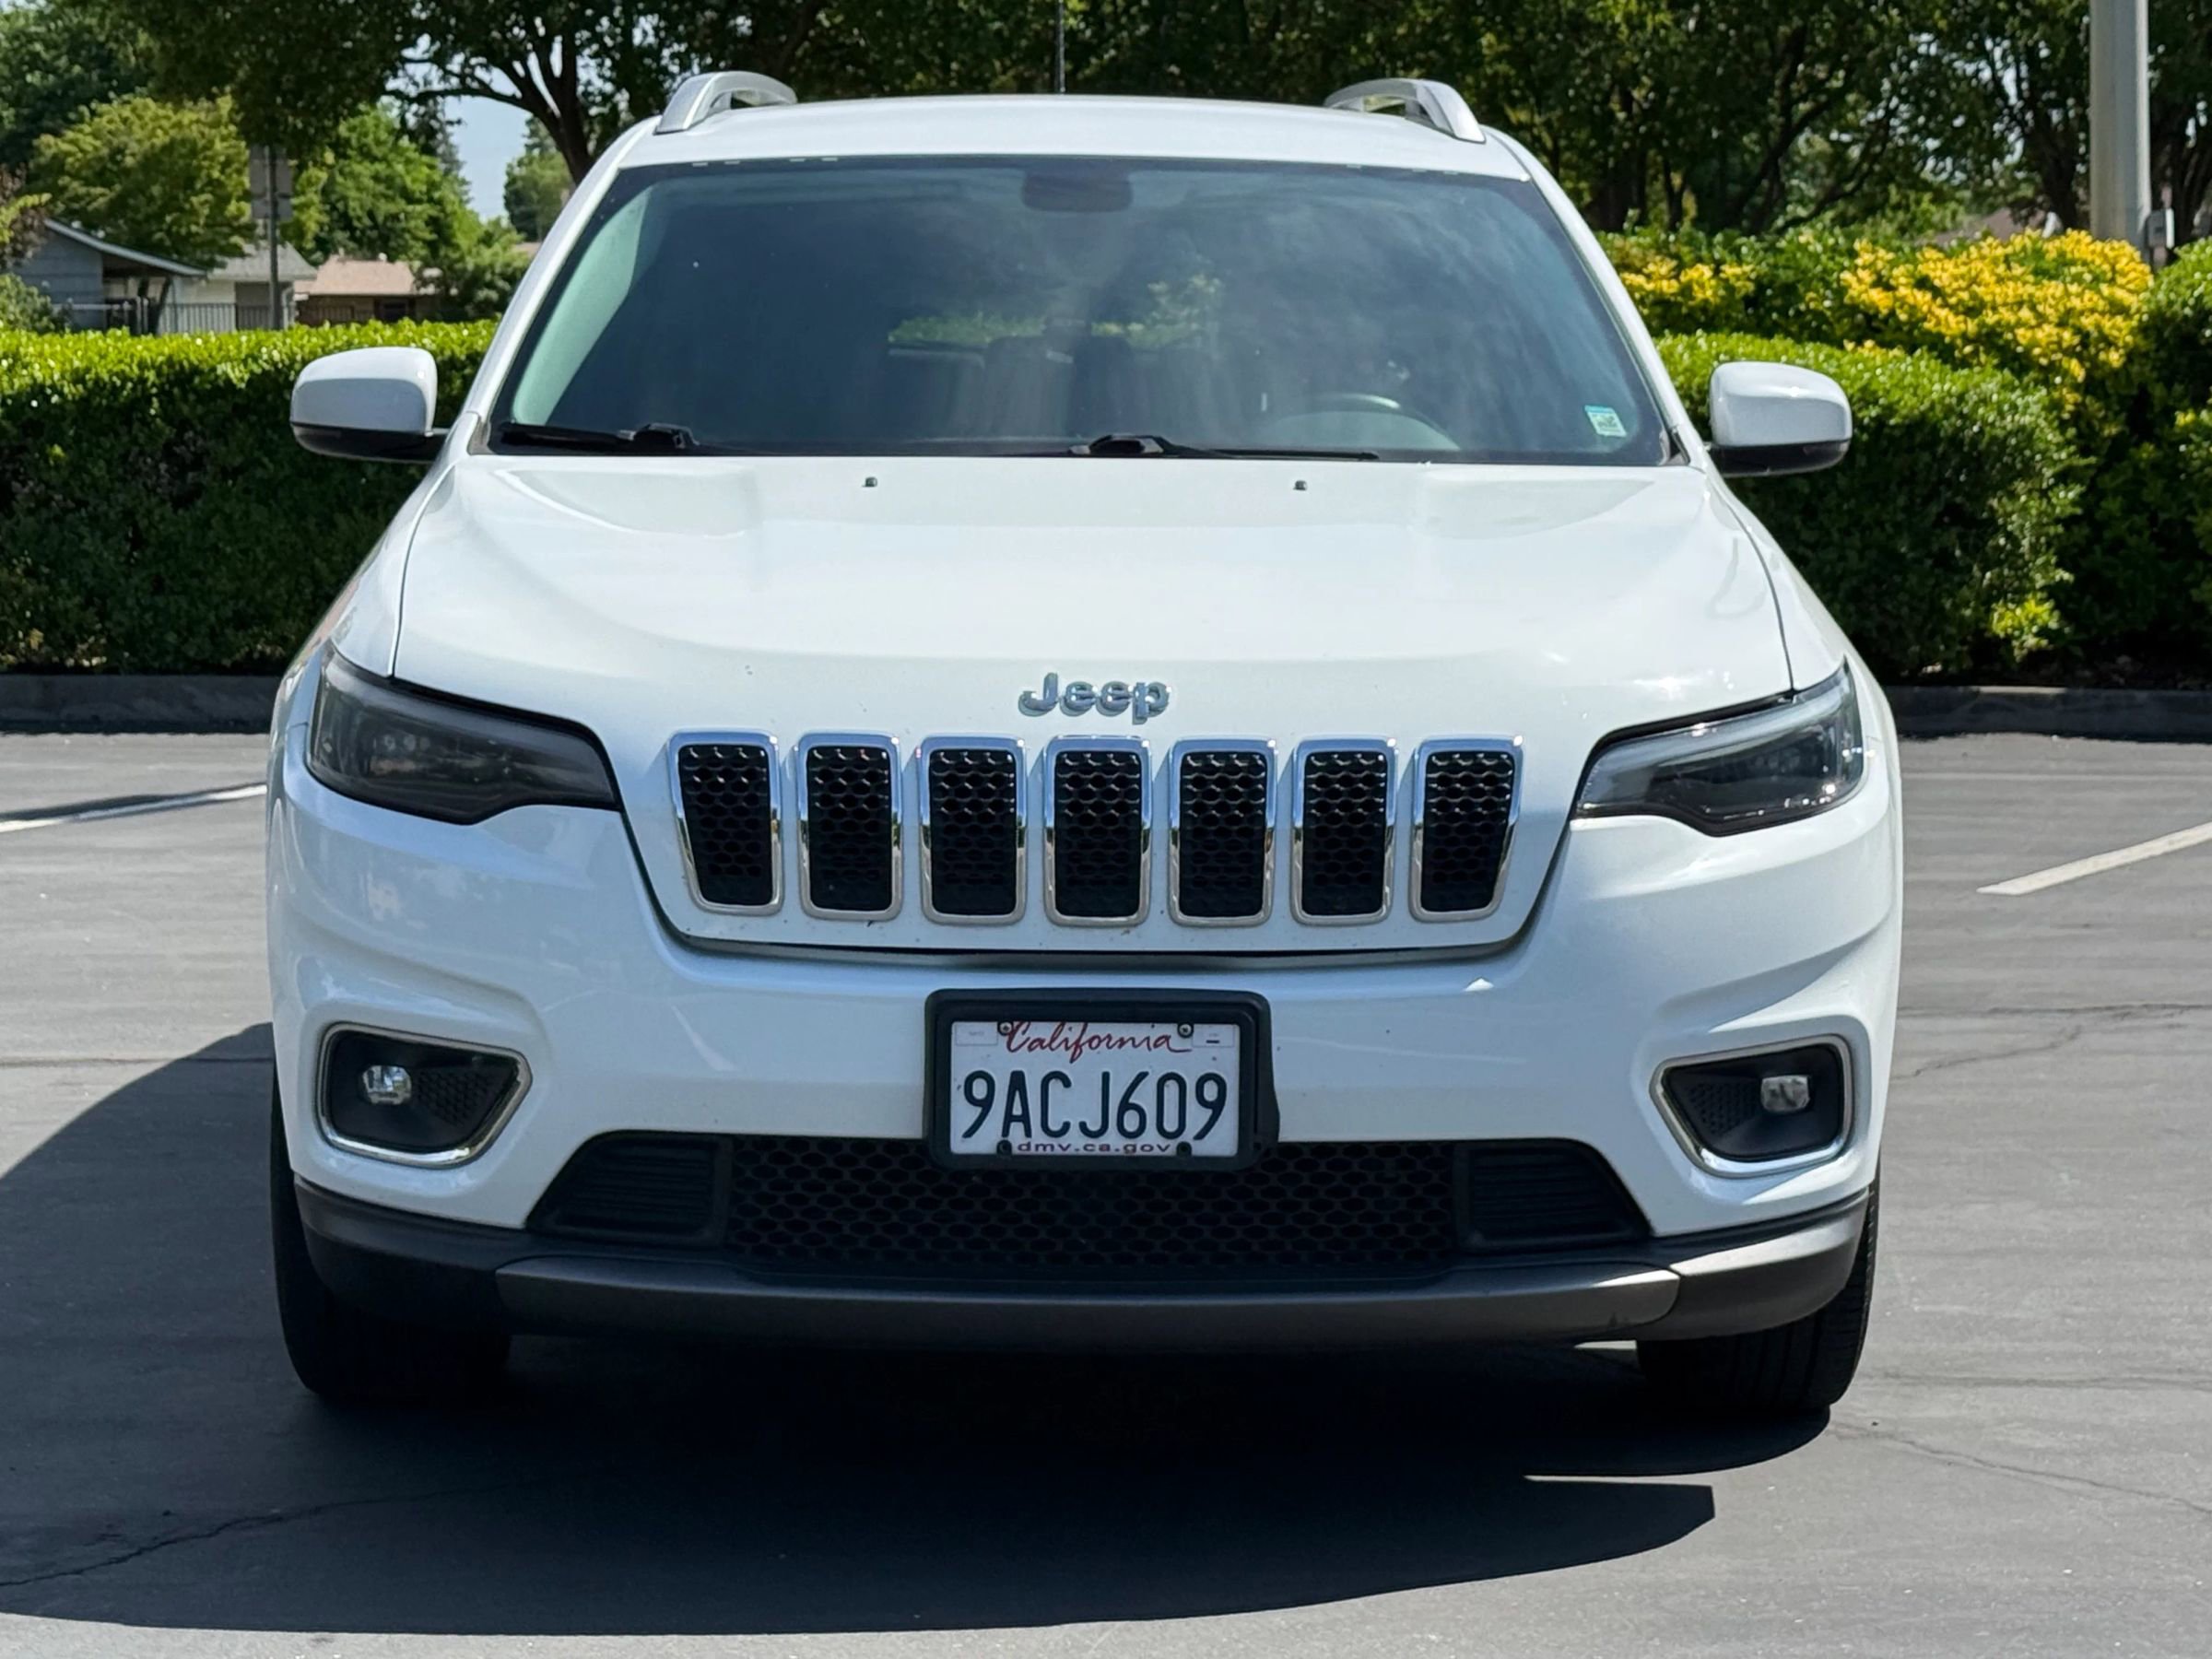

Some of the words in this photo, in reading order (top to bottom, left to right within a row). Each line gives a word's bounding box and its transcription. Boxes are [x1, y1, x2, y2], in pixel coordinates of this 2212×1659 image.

[1018, 672, 1171, 725] Jeep
[1006, 1021, 1192, 1063] California
[961, 1069, 1228, 1141] 9ACJ609
[1017, 1140, 1171, 1154] dmv.ca.gov
